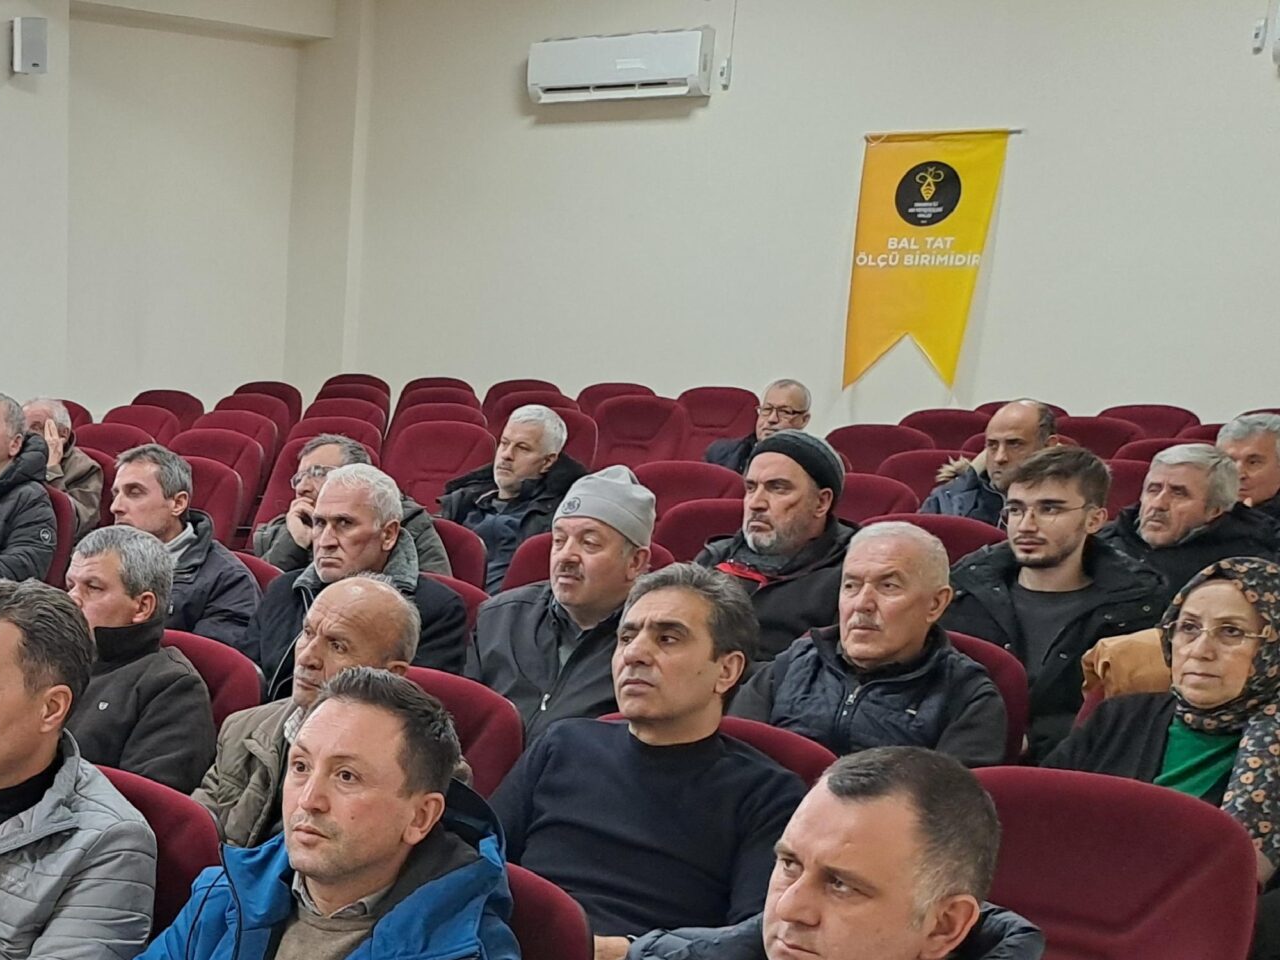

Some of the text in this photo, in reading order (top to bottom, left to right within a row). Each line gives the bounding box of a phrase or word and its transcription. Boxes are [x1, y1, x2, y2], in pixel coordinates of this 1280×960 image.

[887, 236, 956, 249] BAL TAT
[855, 250, 981, 268] ÖLÇÜ BİRİMİDİR
